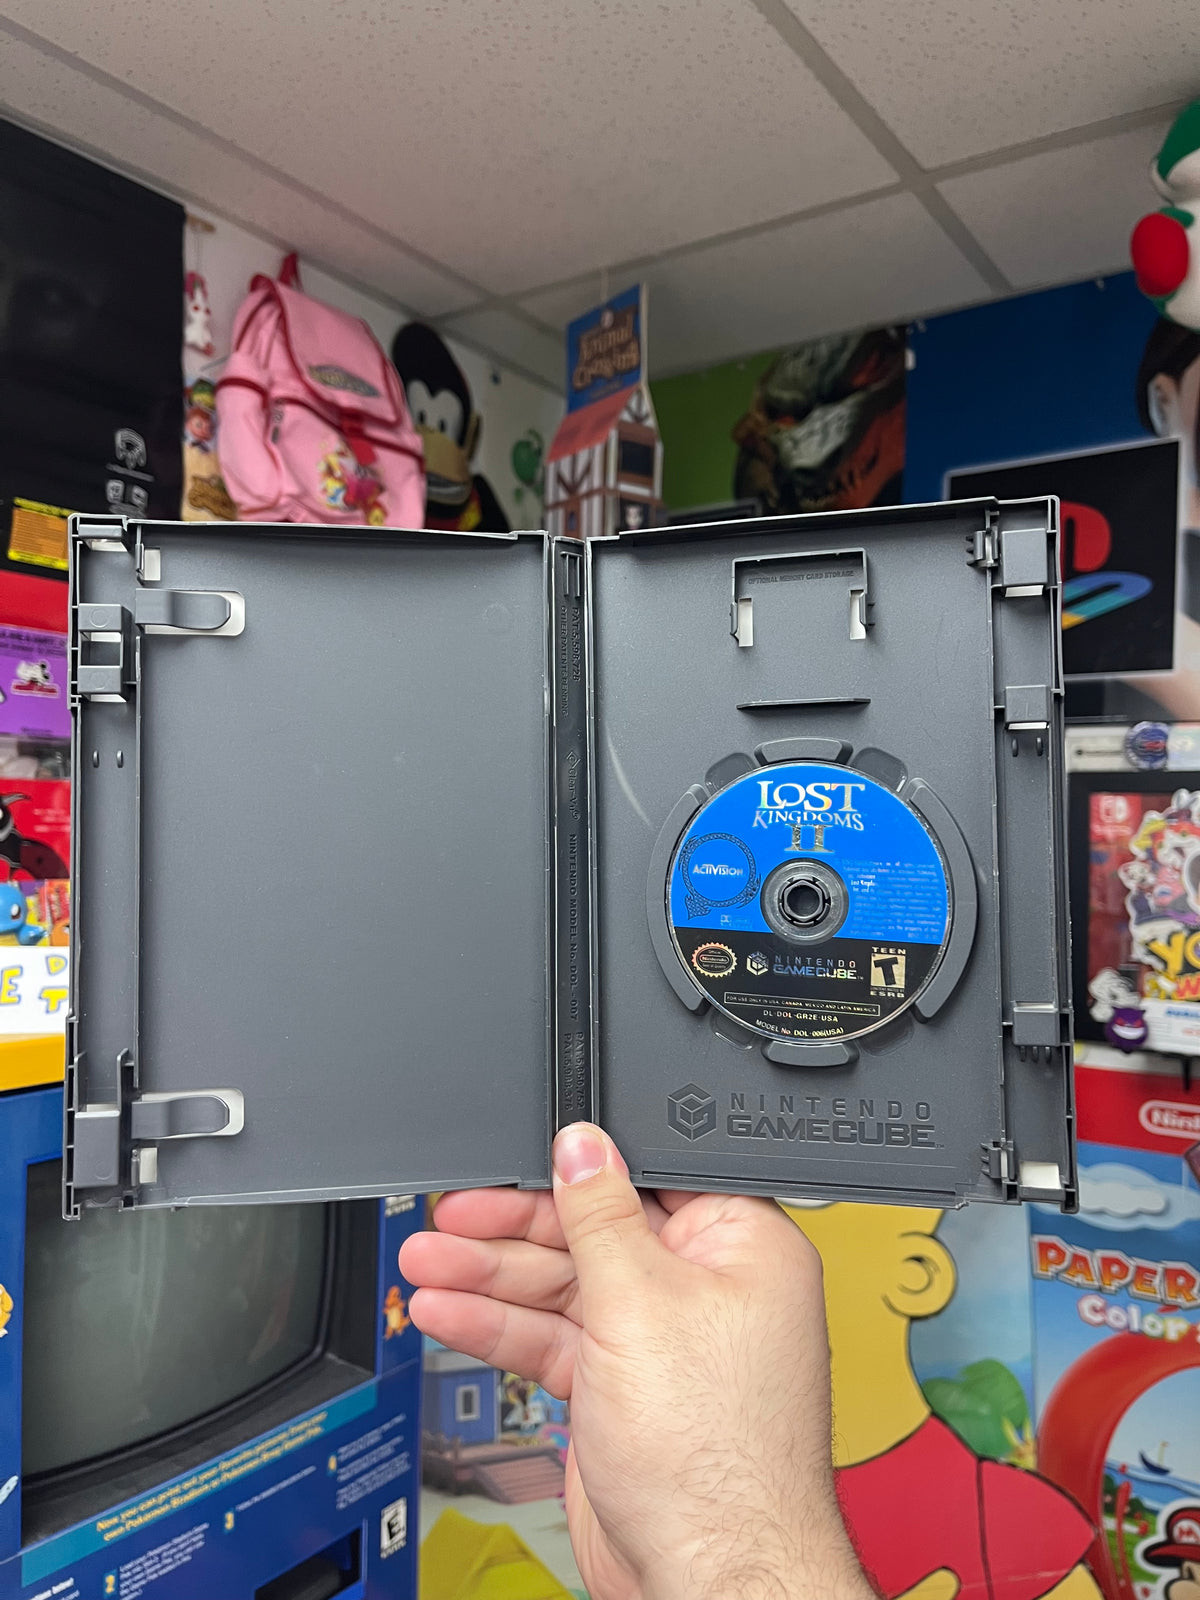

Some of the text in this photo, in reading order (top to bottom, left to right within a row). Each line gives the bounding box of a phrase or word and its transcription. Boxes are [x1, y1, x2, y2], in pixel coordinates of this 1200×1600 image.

[748, 576, 778, 585] OPTIONAL
[824, 570, 854, 579] STORAGE
[757, 780, 866, 812] LOST
[752, 810, 864, 831] KINGDOMS
[569, 899, 577, 940] MODEL
[775, 955, 856, 969] NINTENDO
[871, 946, 906, 955] TEEN
[773, 964, 858, 980] GAMECUBE
[873, 956, 898, 986] T
[869, 990, 905, 998] ESRB
[755, 1019, 780, 1033] MODEL
[731, 1092, 931, 1121] NINTENDO
[727, 1114, 936, 1149] GAMECUBE
[1033, 1236, 1200, 1309] PAPER
[1077, 1294, 1189, 1341] Color
